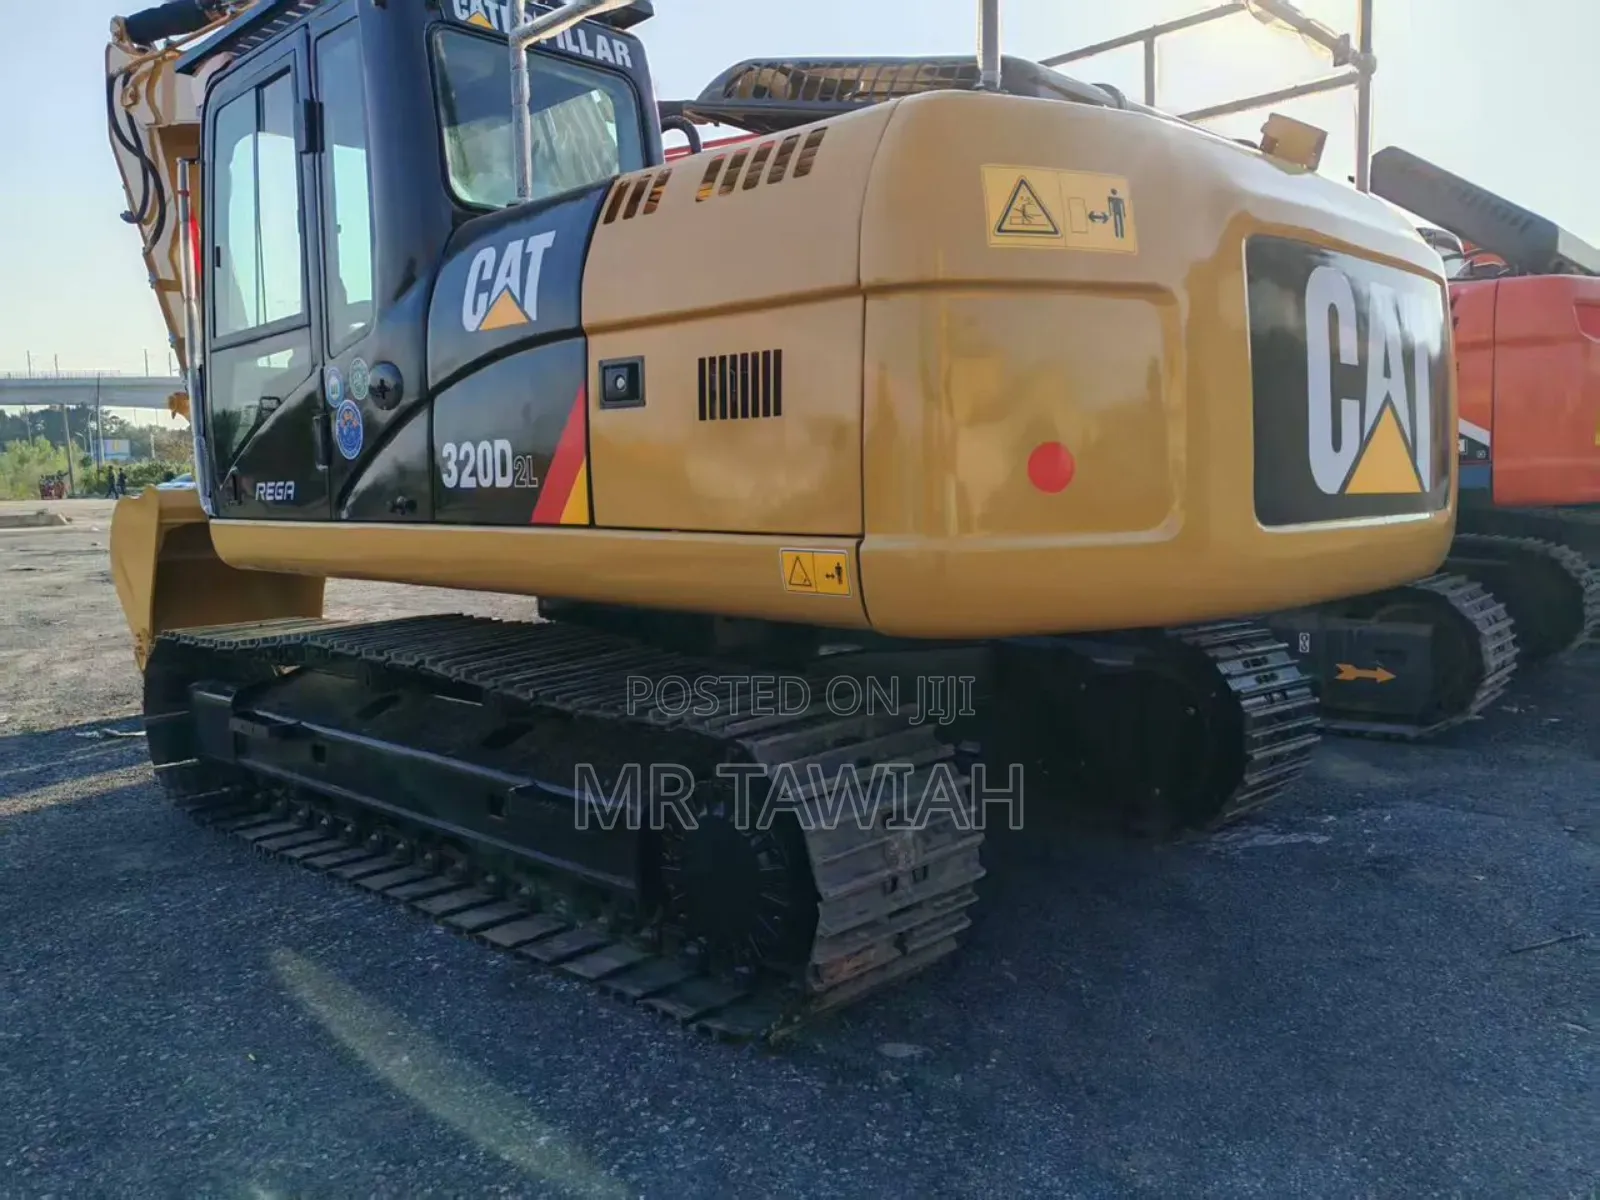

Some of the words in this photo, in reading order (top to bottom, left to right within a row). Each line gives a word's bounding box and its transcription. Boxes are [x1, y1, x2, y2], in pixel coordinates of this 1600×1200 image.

[463, 230, 556, 332] CAT
[1305, 266, 1442, 494] CAT
[255, 481, 295, 500] REGA
